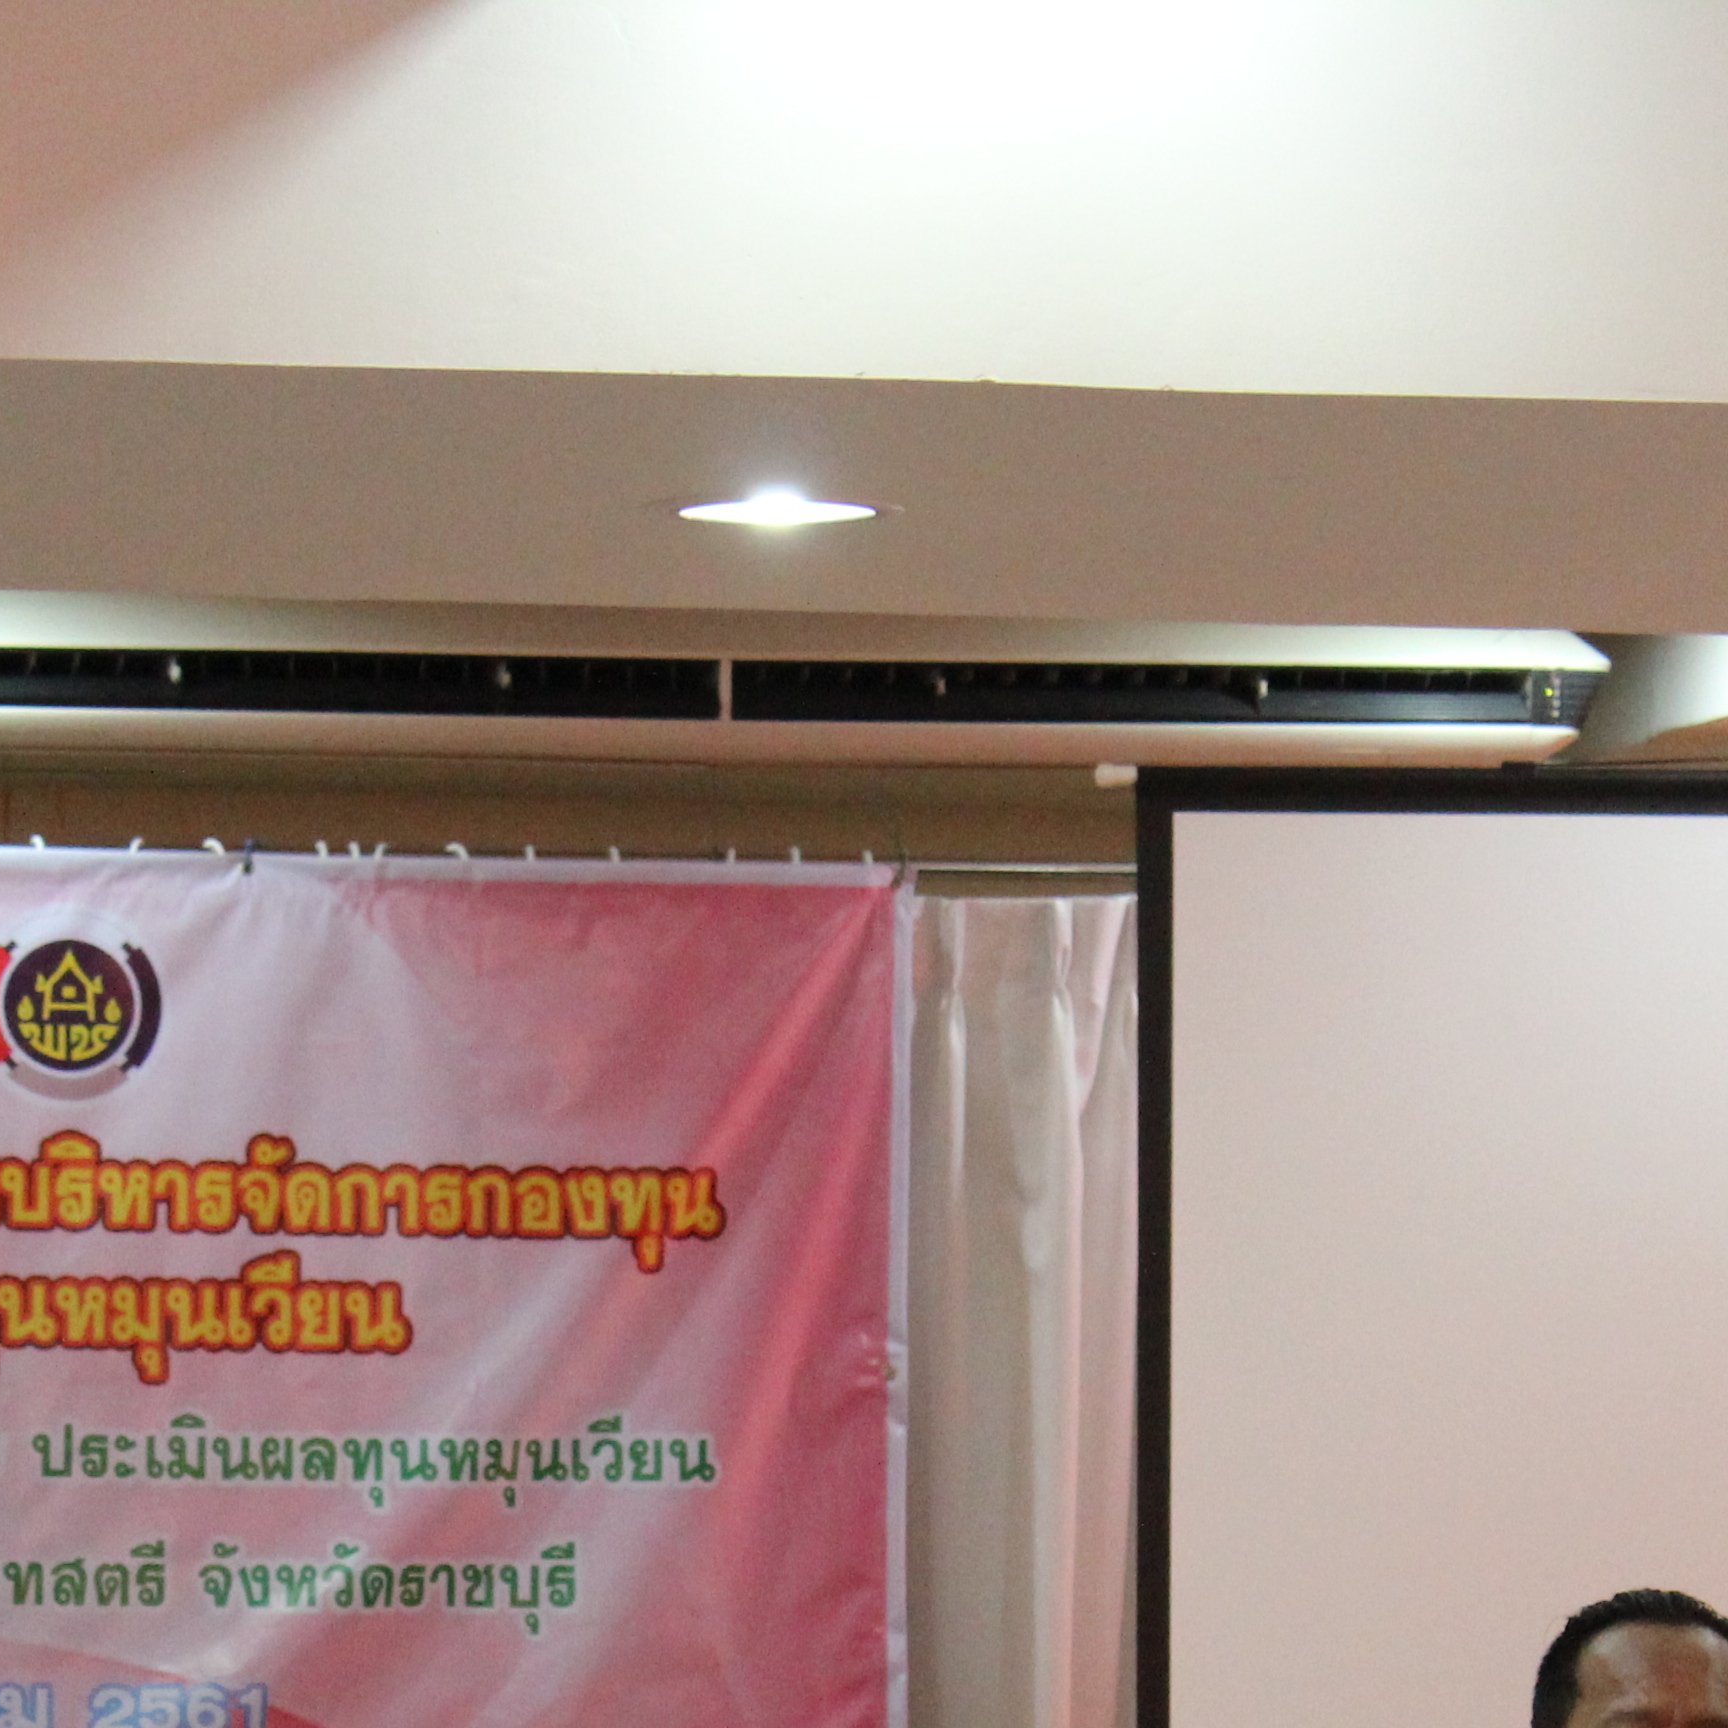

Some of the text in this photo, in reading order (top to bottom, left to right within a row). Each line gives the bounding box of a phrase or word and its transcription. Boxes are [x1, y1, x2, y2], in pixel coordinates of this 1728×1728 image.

[32, 1414, 715, 1507] ประเมินผลทุนหมุนเวียน
[200, 1542, 577, 1635] จังหวัดราชบุรี
